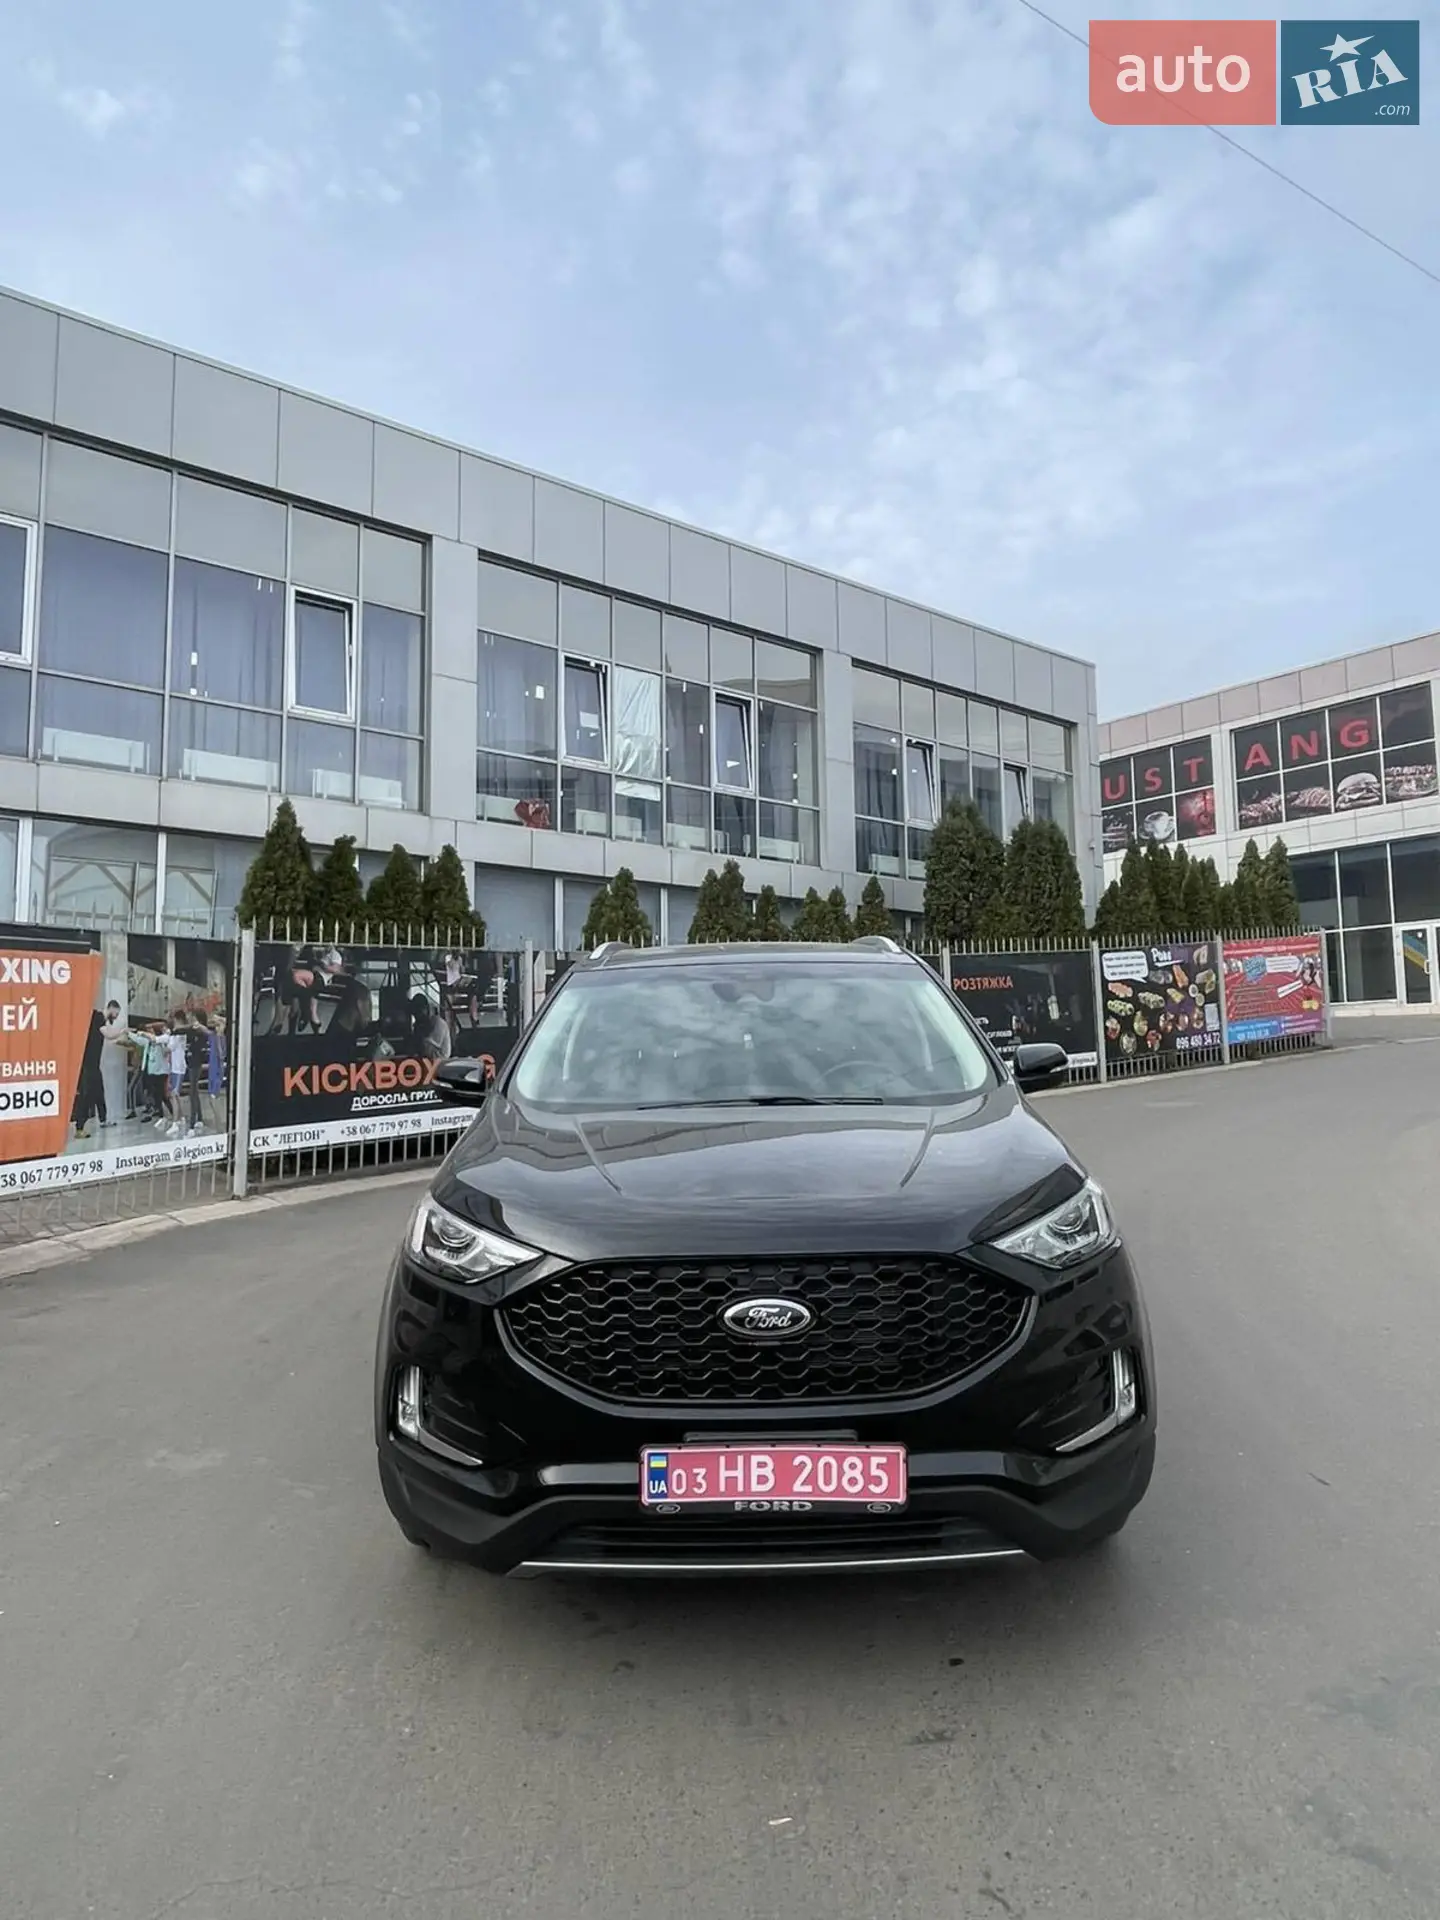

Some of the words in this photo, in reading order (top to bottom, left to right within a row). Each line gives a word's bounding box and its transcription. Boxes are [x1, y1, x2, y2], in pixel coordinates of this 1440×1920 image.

[1245, 718, 1370, 771] ANG
[953, 975, 1014, 991] РОЗТЯЖКА
[2, 997, 38, 1032] ЕЙ
[0, 1061, 56, 1078] ВАННЯ
[350, 1093, 408, 1110] ДОРОСЛА
[253, 1135, 270, 1148] СК
[359, 1124, 377, 1135] 067
[379, 1121, 396, 1133] 779
[398, 1120, 410, 1131] 97
[20, 1170, 43, 1185] 067
[46, 1165, 69, 1180] 779
[72, 1162, 86, 1176] 97
[89, 1160, 103, 1173] 98
[115, 1152, 171, 1169] Instagram
[744, 1306, 792, 1328] Ford
[649, 1480, 667, 1494] UA
[671, 1468, 707, 1495] 03
[719, 1454, 775, 1493] HB
[792, 1454, 889, 1494] 2085
[734, 1501, 813, 1511] FORD
